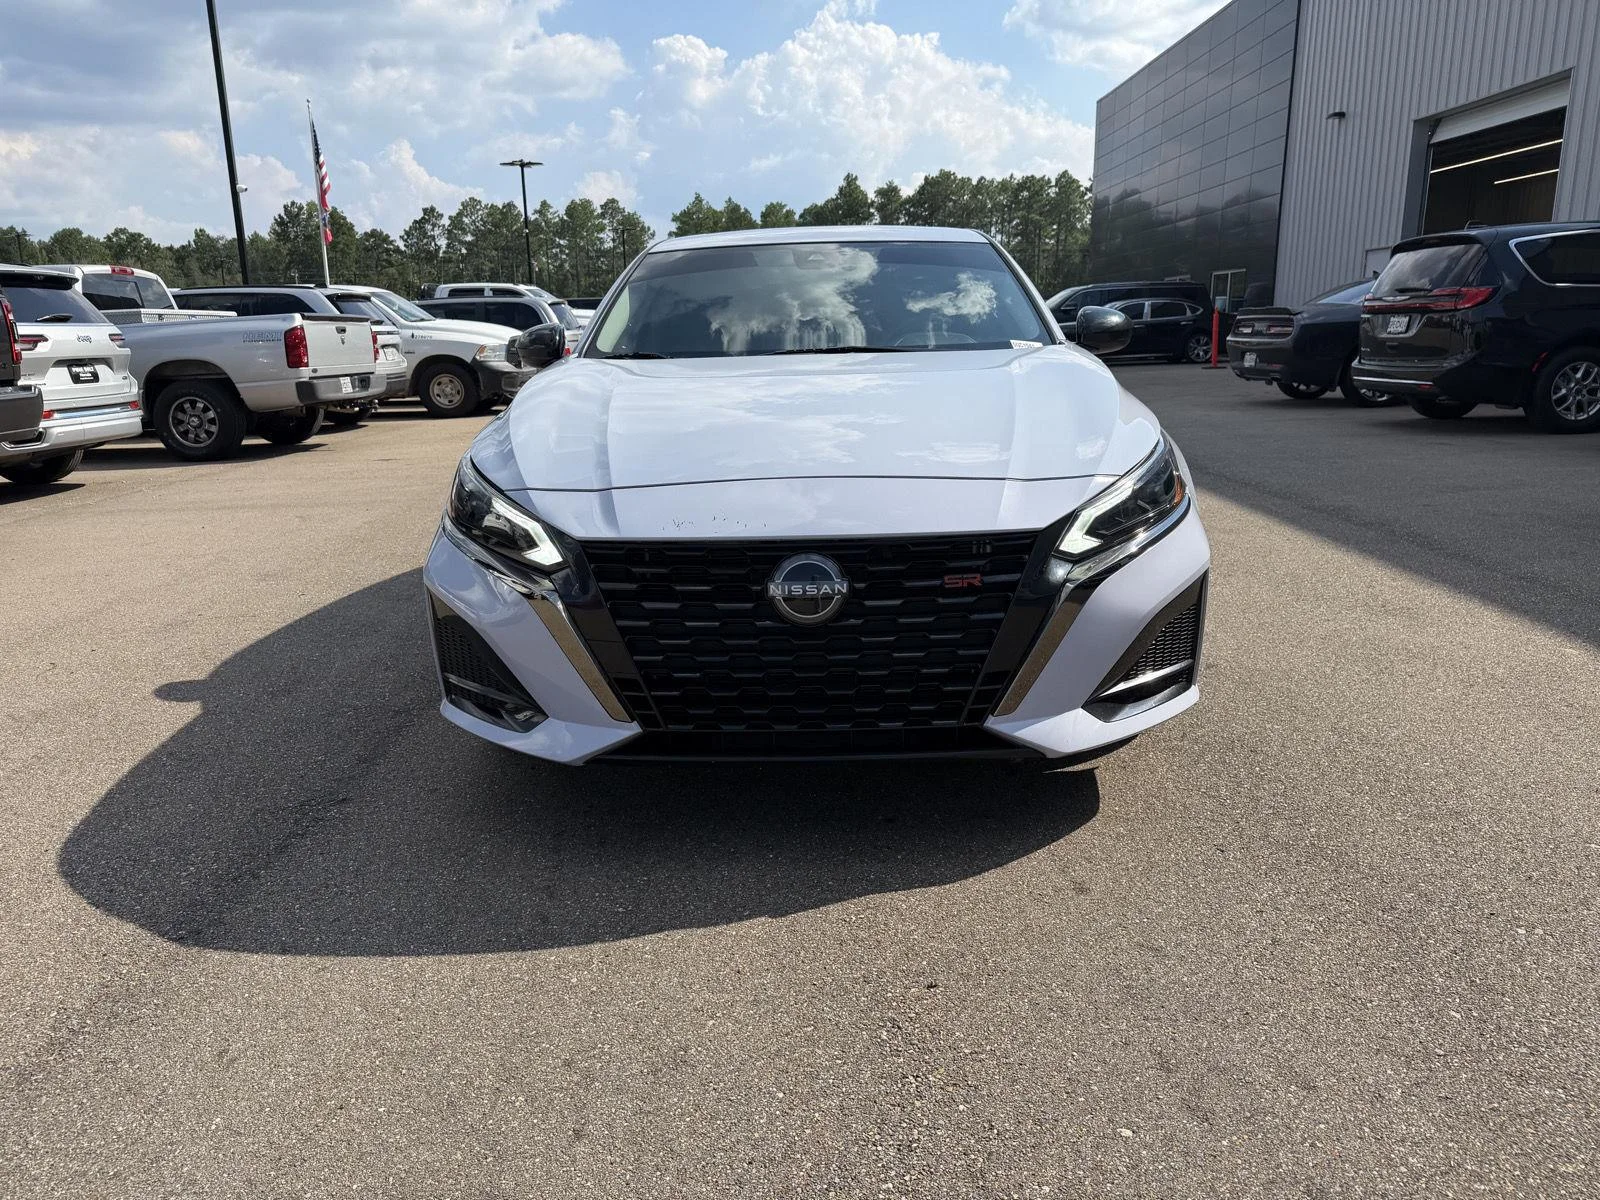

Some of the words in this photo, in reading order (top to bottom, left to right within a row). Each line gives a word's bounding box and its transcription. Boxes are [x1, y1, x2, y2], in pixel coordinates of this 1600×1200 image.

[77, 334, 92, 344] Jeep
[944, 574, 983, 588] SR
[770, 584, 847, 595] NISSAN
